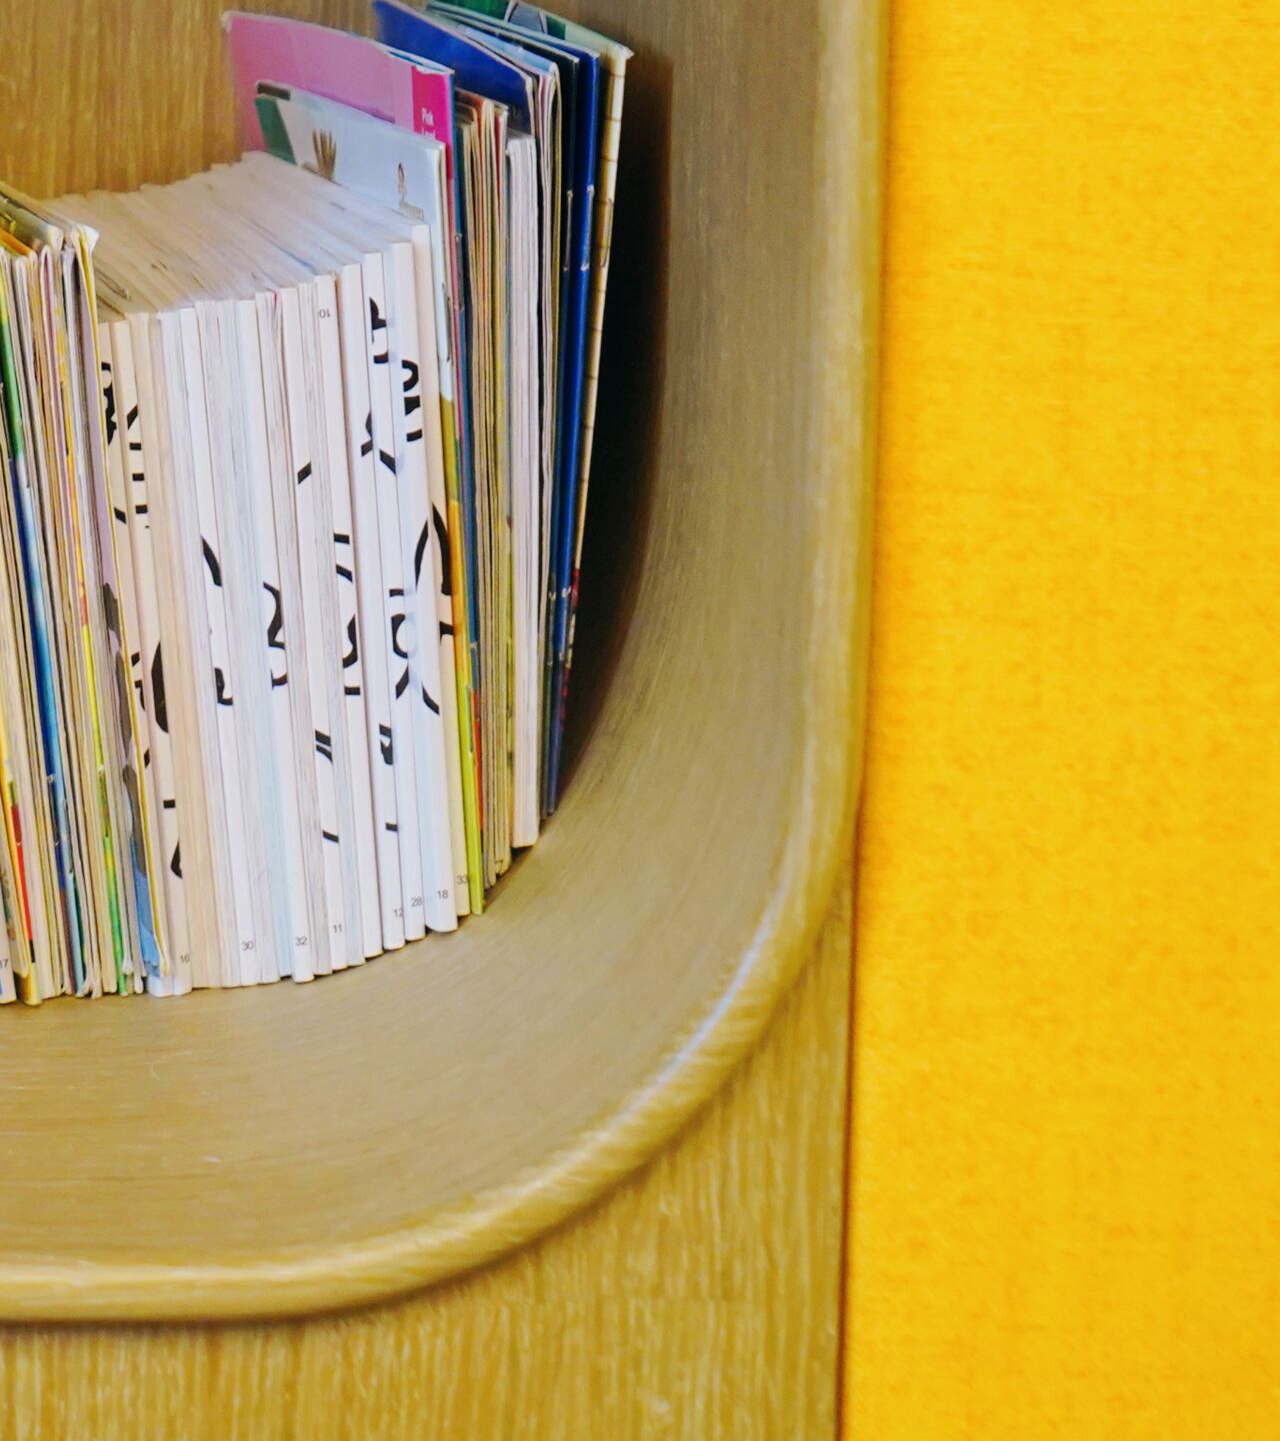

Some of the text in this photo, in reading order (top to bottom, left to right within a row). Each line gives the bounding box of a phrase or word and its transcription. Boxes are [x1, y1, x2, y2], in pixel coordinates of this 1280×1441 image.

[438, 890, 448, 900] 18
[332, 924, 343, 933] 11
[242, 941, 254, 951] 30
[295, 936, 307, 947] 32
